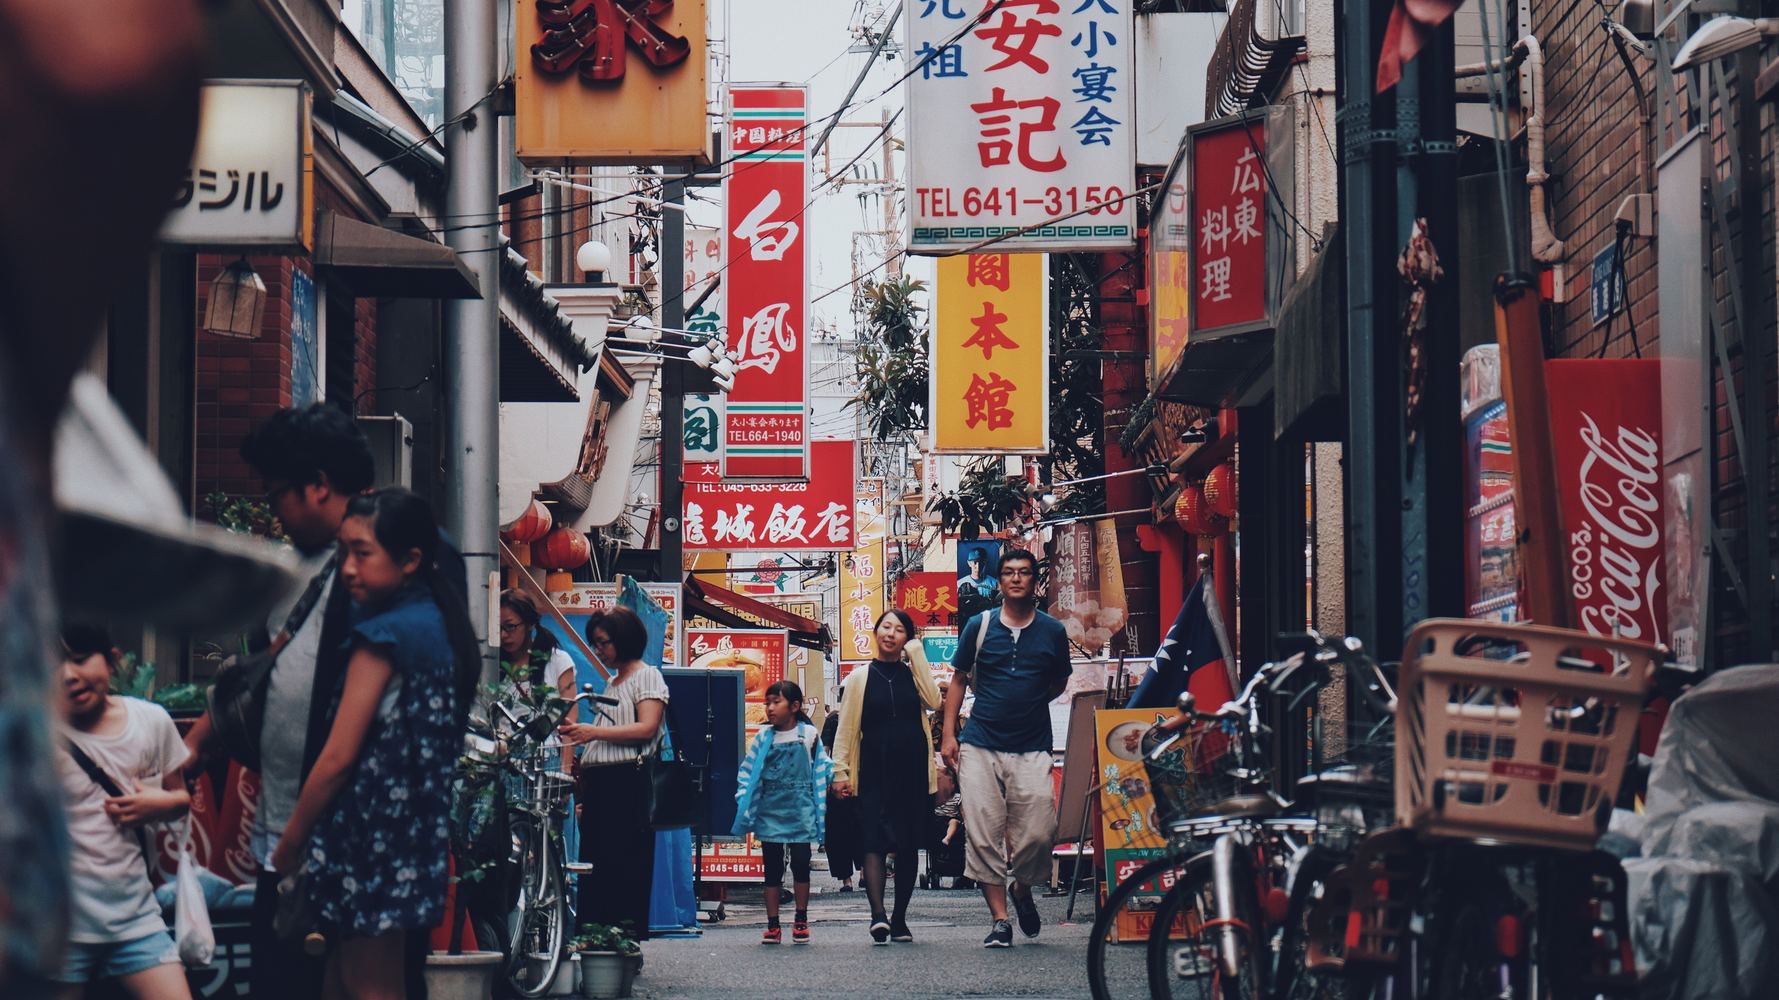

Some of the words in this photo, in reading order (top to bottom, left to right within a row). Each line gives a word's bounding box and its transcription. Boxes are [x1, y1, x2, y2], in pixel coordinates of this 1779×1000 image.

[732, 126, 802, 144] 中国料理
[970, 0, 1067, 173] 安記
[1231, 147, 1263, 246] 広東
[732, 188, 800, 376] 白鳳
[1201, 205, 1233, 303] 料理
[730, 416, 801, 428] 大小宴会承ります
